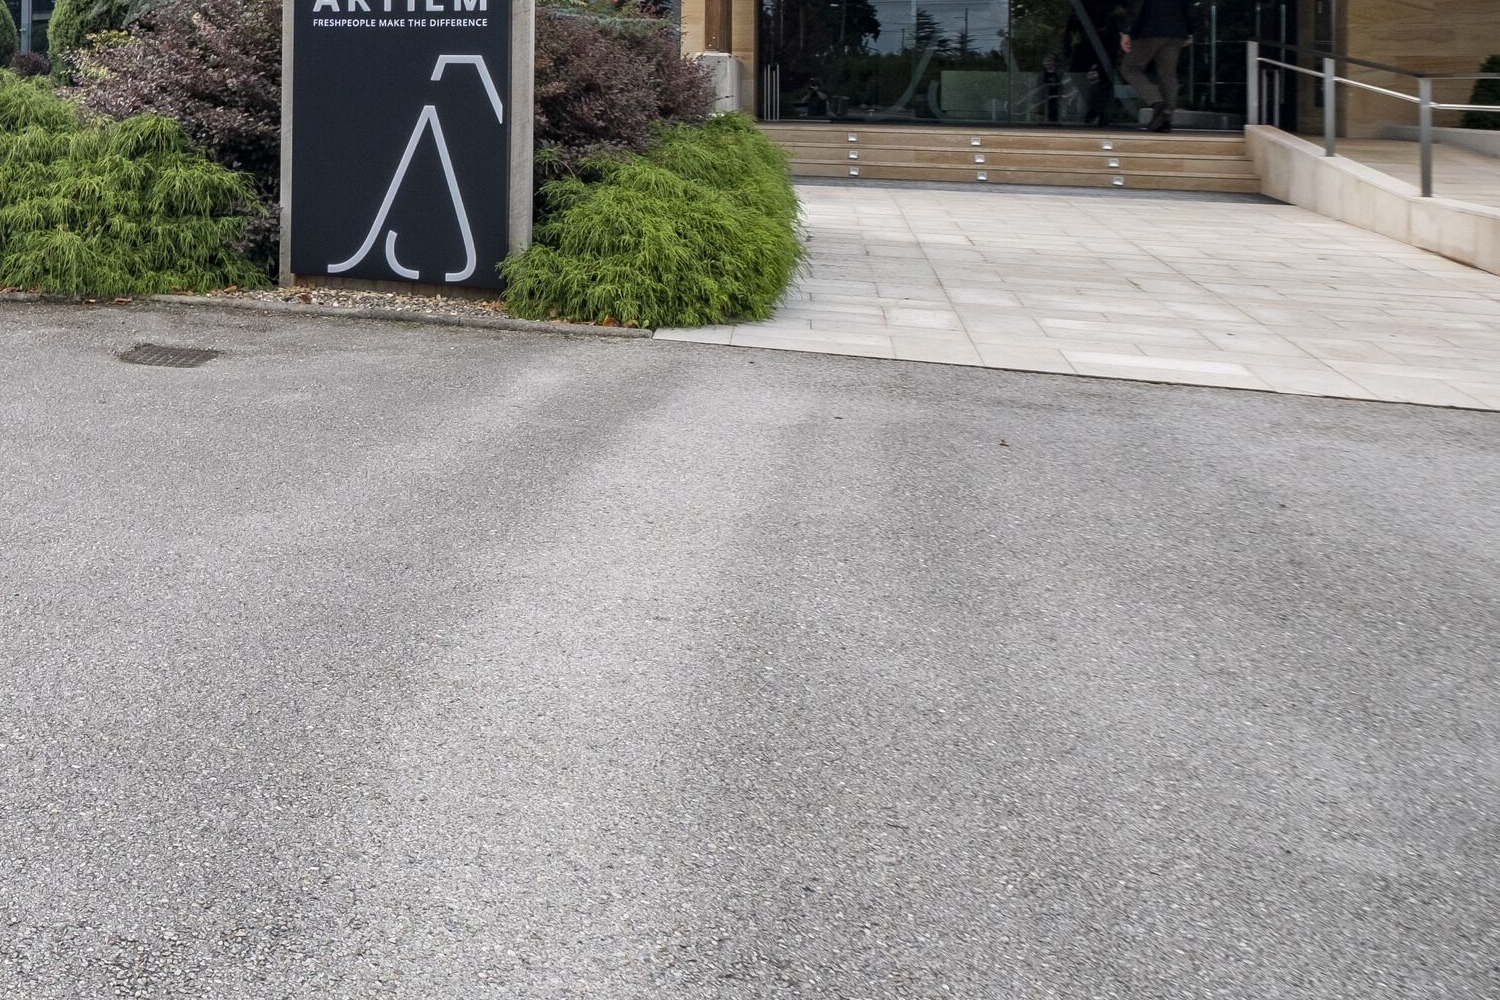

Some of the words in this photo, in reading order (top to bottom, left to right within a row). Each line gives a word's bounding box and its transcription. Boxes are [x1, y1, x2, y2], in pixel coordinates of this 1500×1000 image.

[312, 18, 376, 28] FRESHPEOPLE
[378, 18, 406, 28] MAKE
[408, 18, 427, 27] THE
[429, 18, 488, 27] DIFFERENCE
